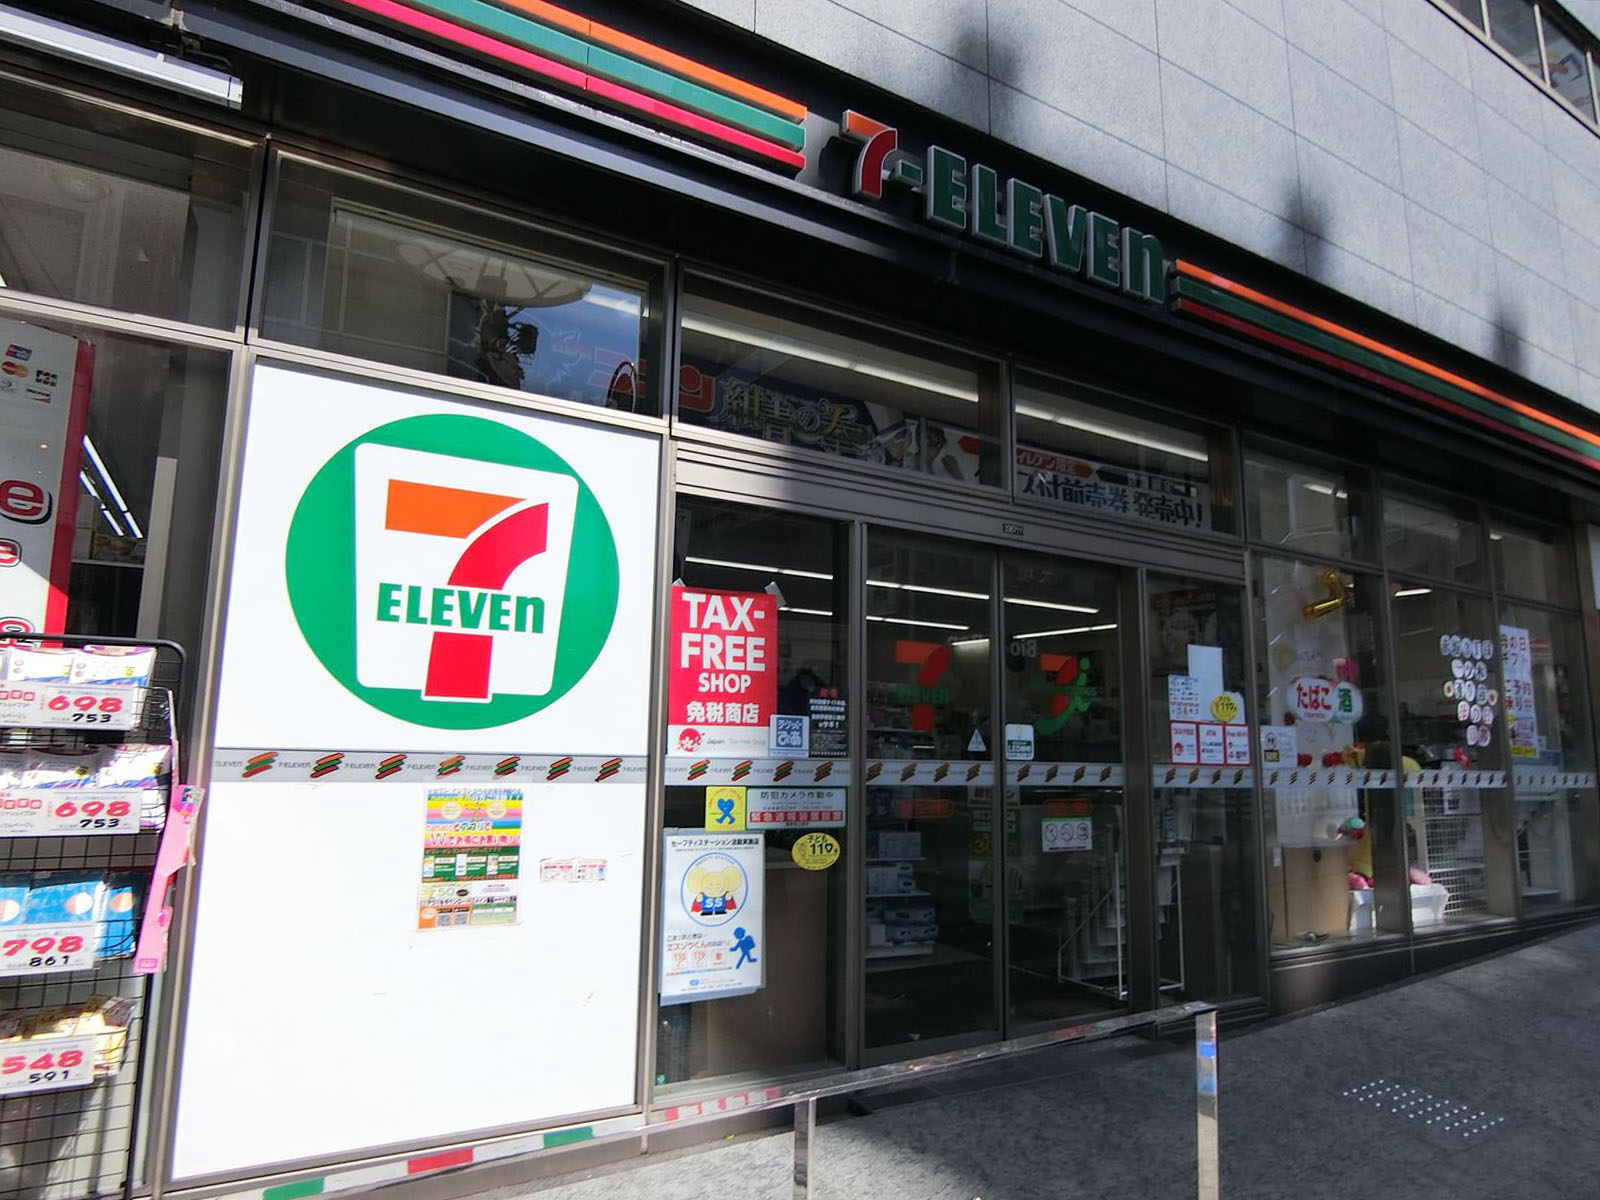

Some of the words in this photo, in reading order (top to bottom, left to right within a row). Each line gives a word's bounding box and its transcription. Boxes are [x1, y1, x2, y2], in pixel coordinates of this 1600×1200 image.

[385, 478, 549, 699] 7
[681, 592, 765, 632] TAX-
[680, 633, 766, 671] FREE
[698, 673, 752, 694] SHOP
[47, 695, 123, 713] 698
[1297, 683, 1332, 710] たばこ
[72, 713, 113, 723] 753
[686, 701, 760, 724] 免税商店
[760, 791, 834, 800] 防犯カメラ作動中
[55, 800, 131, 818] 698
[79, 818, 121, 828] 753
[704, 897, 723, 908] SS
[2, 935, 84, 956] 798
[29, 955, 70, 967] 861
[1, 1050, 84, 1075] 548
[29, 1070, 70, 1083] 591
